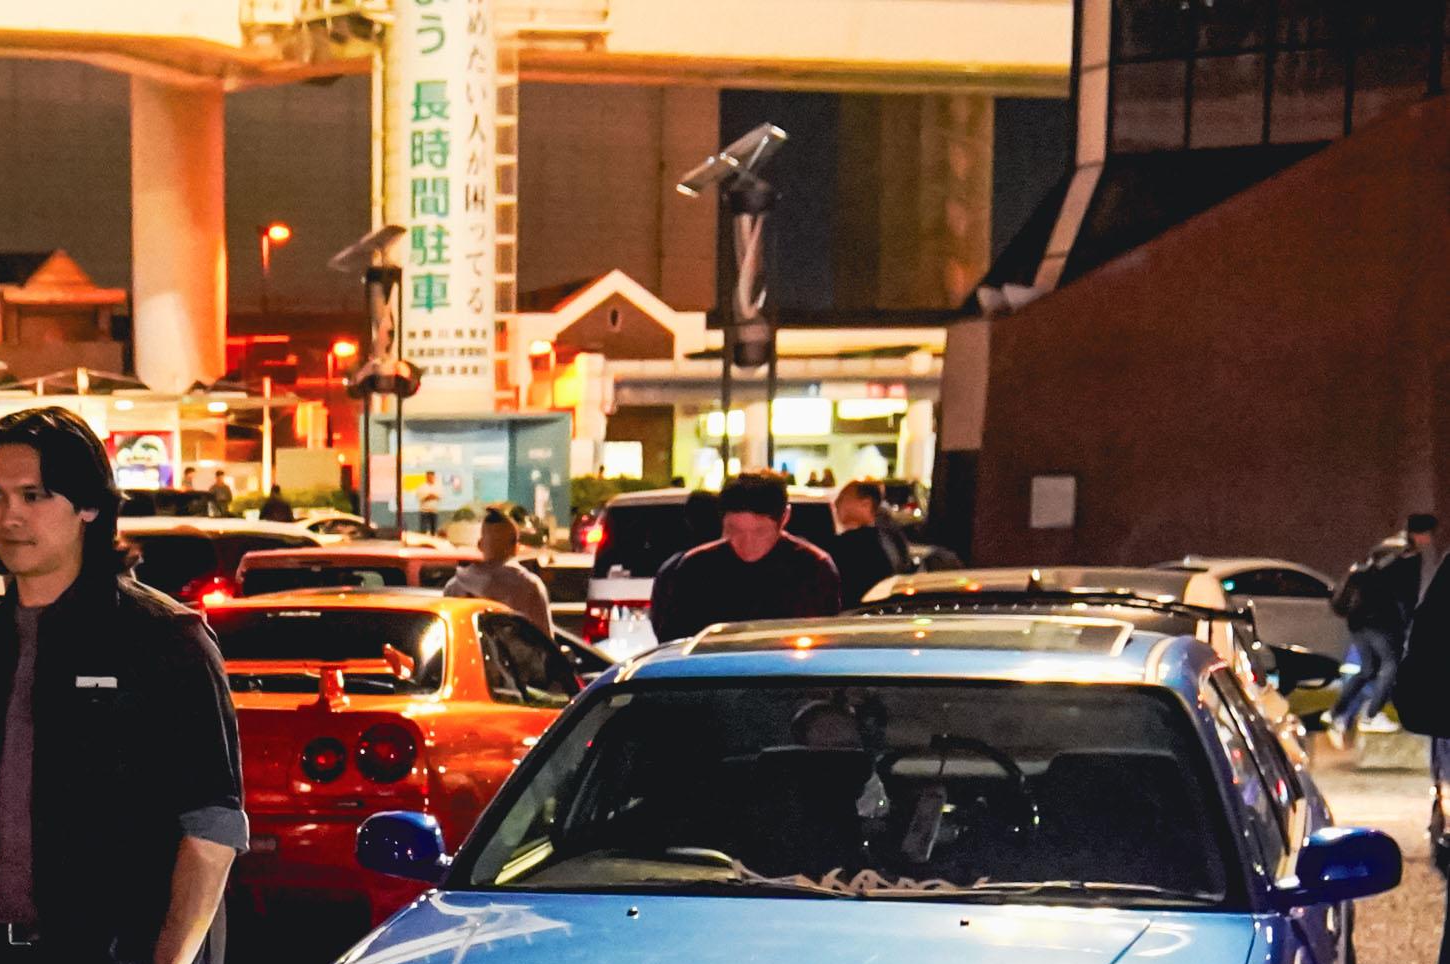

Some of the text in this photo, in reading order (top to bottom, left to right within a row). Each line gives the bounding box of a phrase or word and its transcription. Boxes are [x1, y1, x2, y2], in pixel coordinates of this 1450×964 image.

[415, 0, 445, 55] う
[411, 80, 450, 313] 長時間駐車
[464, 0, 487, 314] めたい人が困ってる
